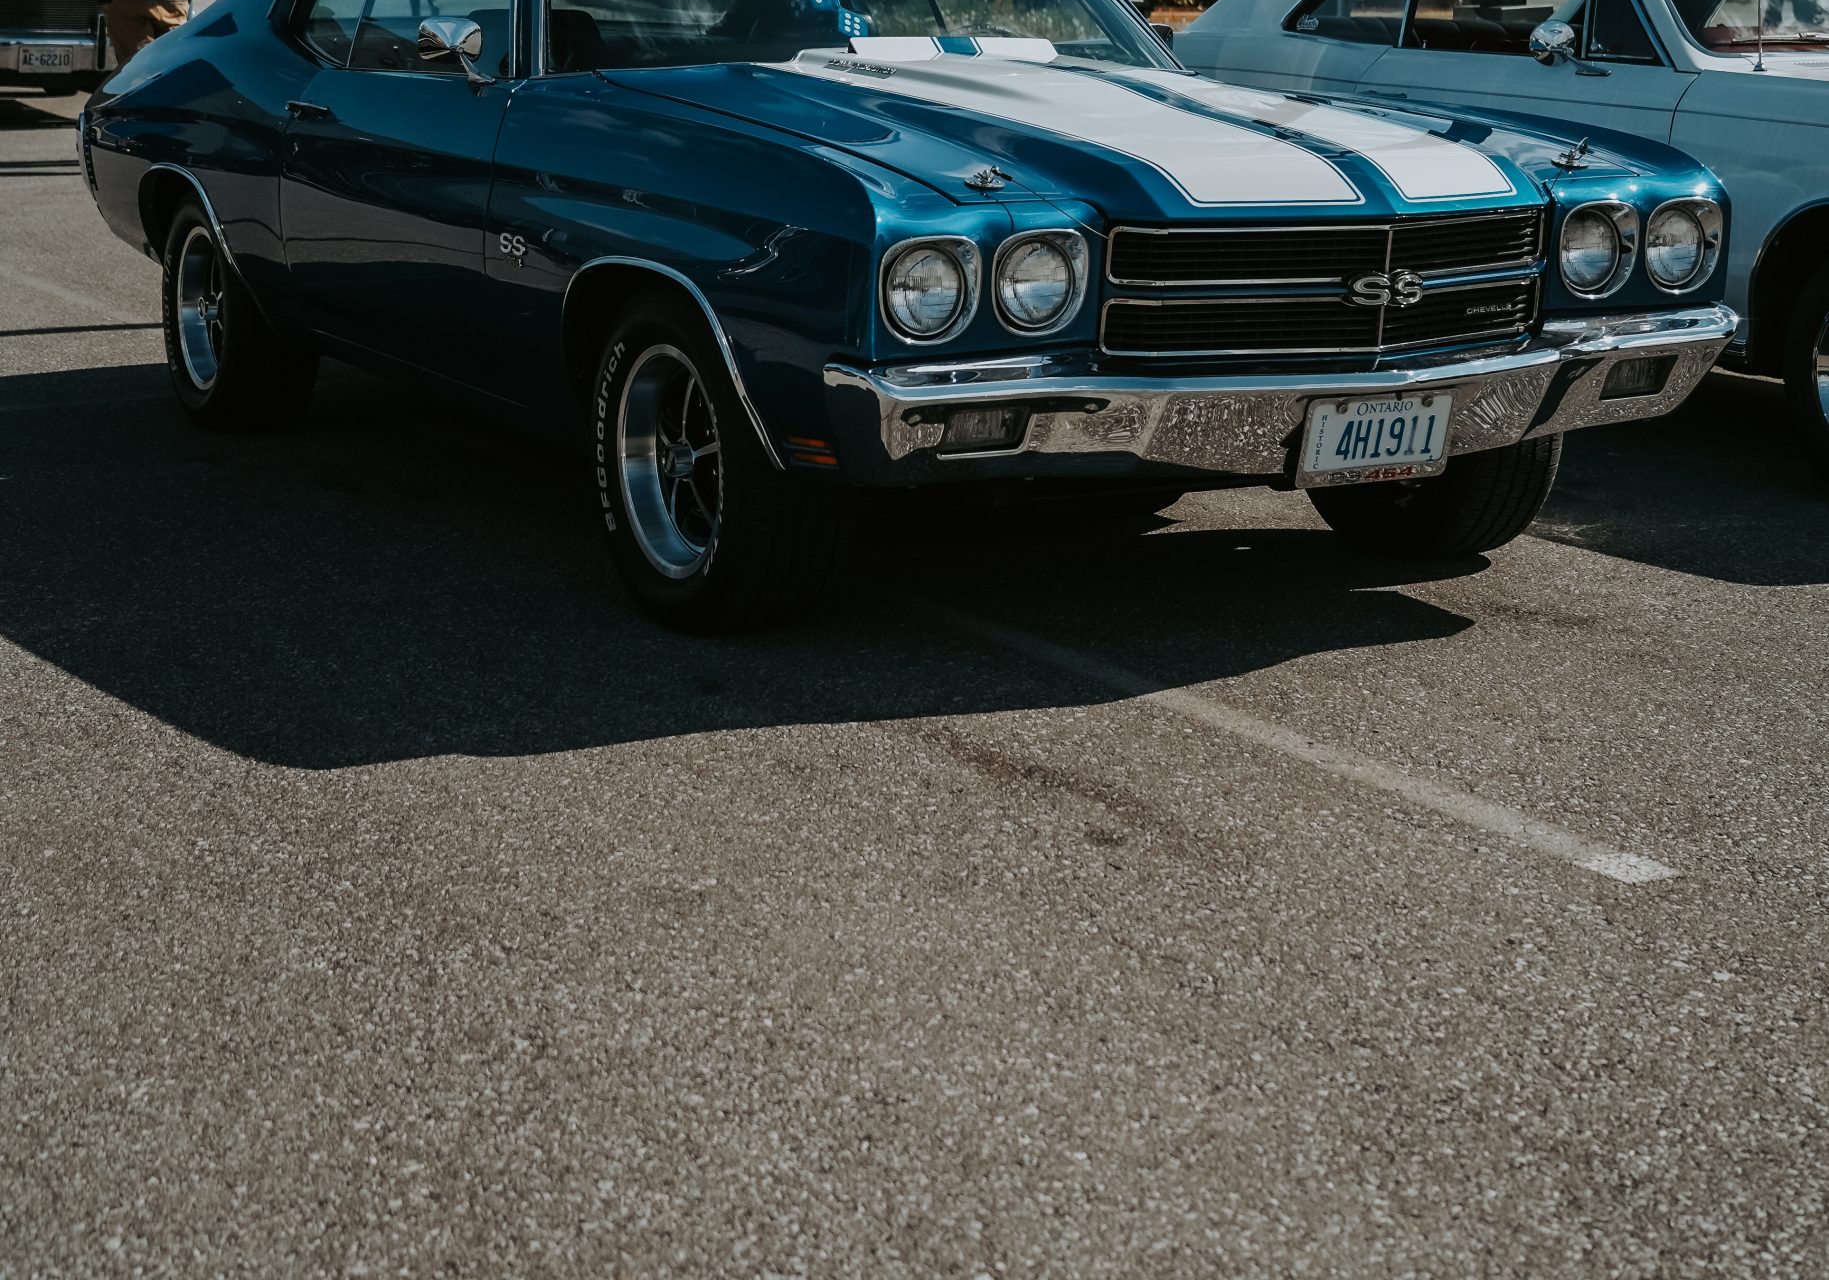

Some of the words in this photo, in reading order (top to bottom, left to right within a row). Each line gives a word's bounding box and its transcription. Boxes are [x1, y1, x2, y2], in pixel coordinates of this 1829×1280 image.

[500, 232, 526, 256] SS
[1352, 271, 1424, 306] SS
[1312, 415, 1328, 470] HISTORIC
[1335, 415, 1436, 461] 4H1911
[1364, 466, 1414, 480] 454
